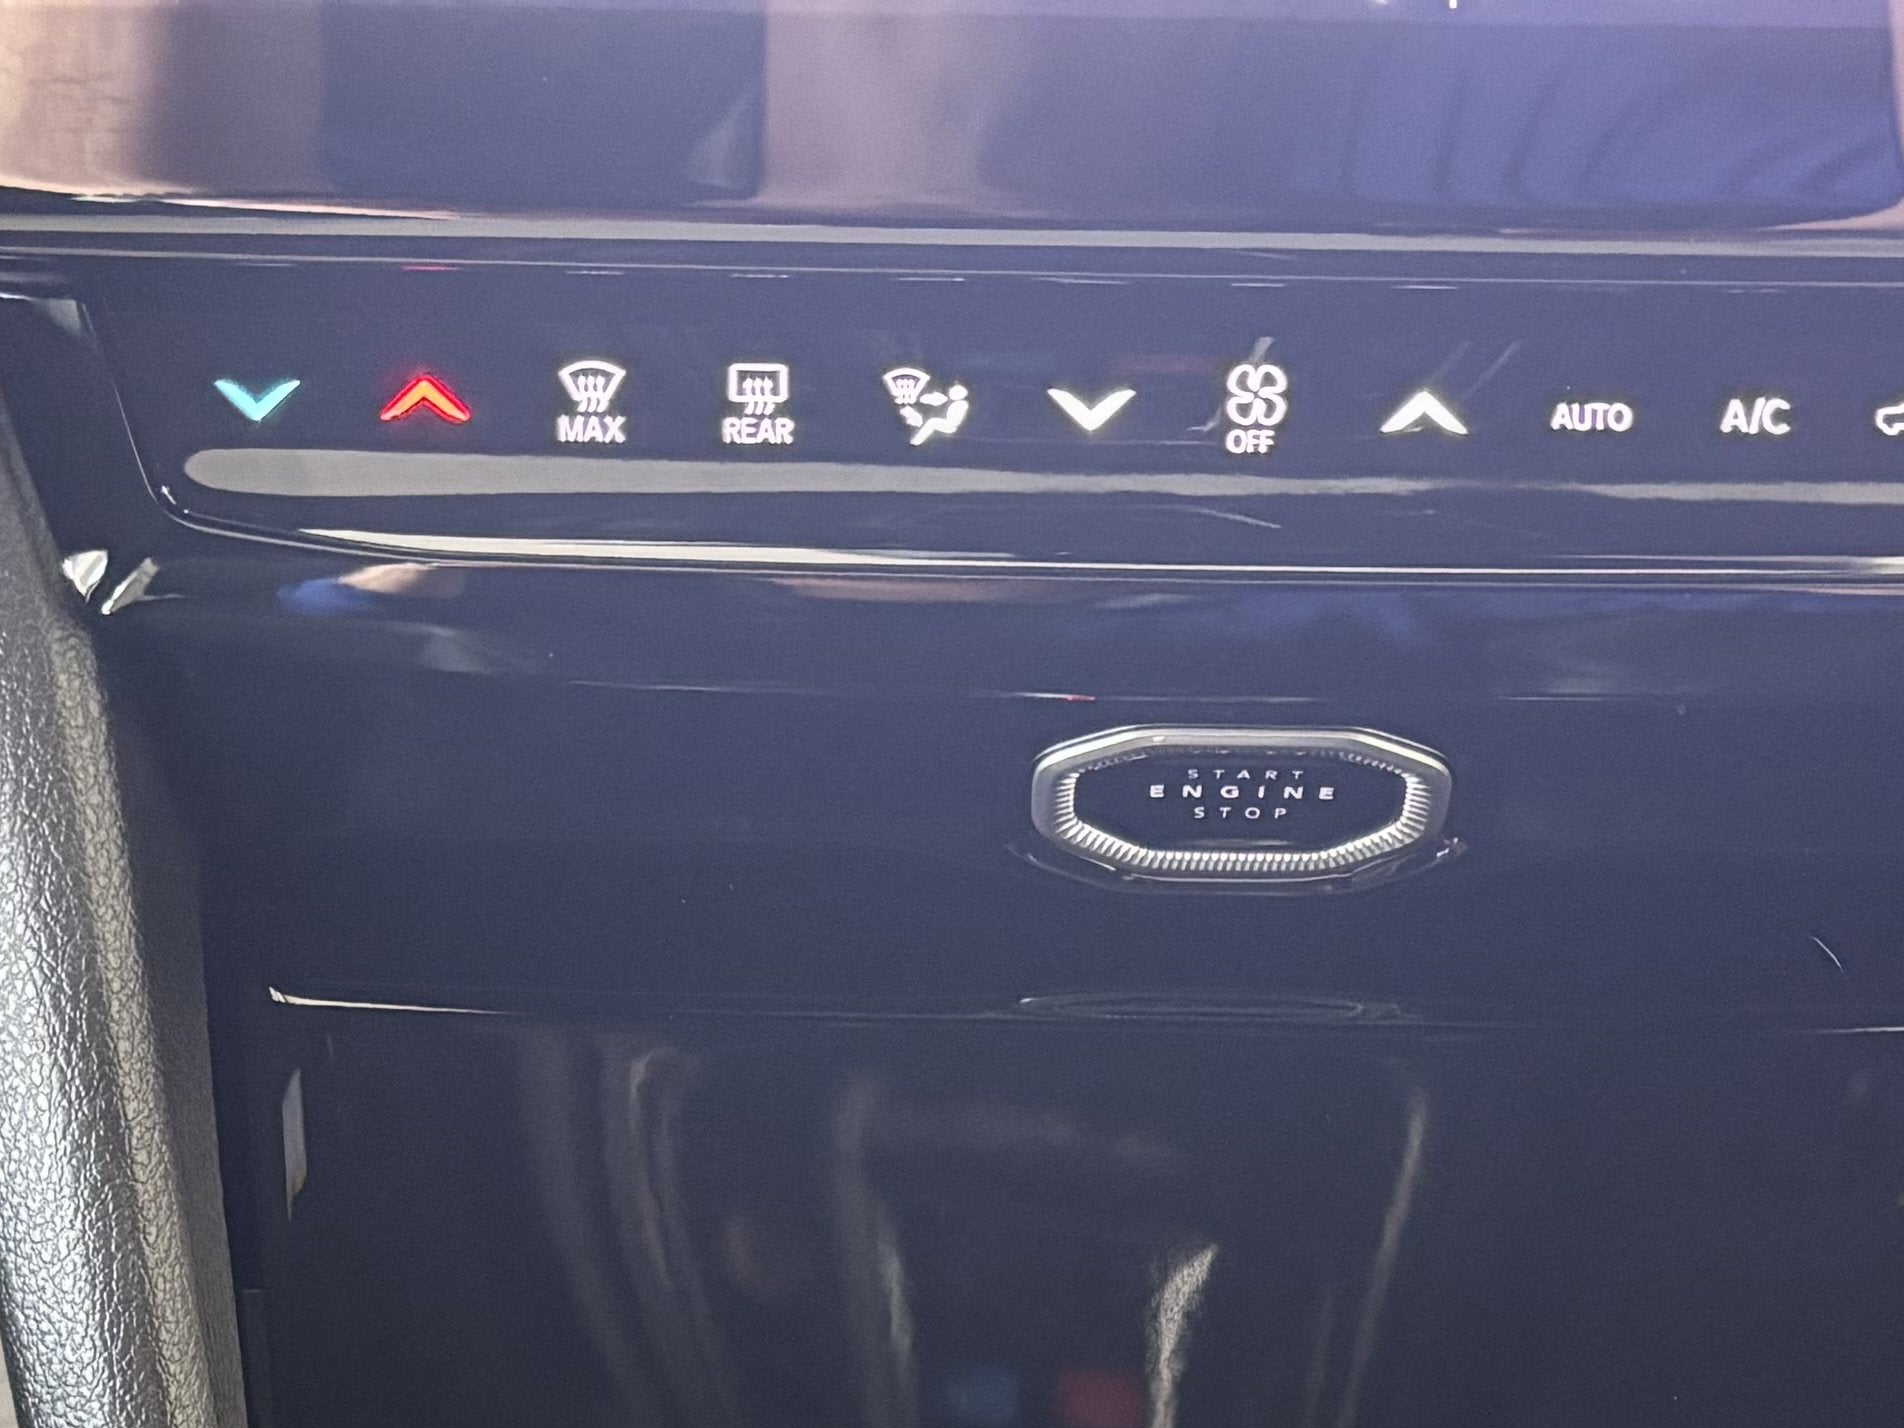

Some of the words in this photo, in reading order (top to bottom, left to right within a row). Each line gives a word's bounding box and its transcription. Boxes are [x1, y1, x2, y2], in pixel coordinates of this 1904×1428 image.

[557, 414, 626, 443] MAX
[1550, 402, 1634, 432] AUTO
[1720, 397, 1791, 434] A/C
[722, 416, 795, 444] REAR
[1225, 429, 1276, 454] OFF
[1187, 769, 1304, 779] START
[1149, 784, 1335, 800] ENGINE
[1194, 807, 1287, 819] STOP
